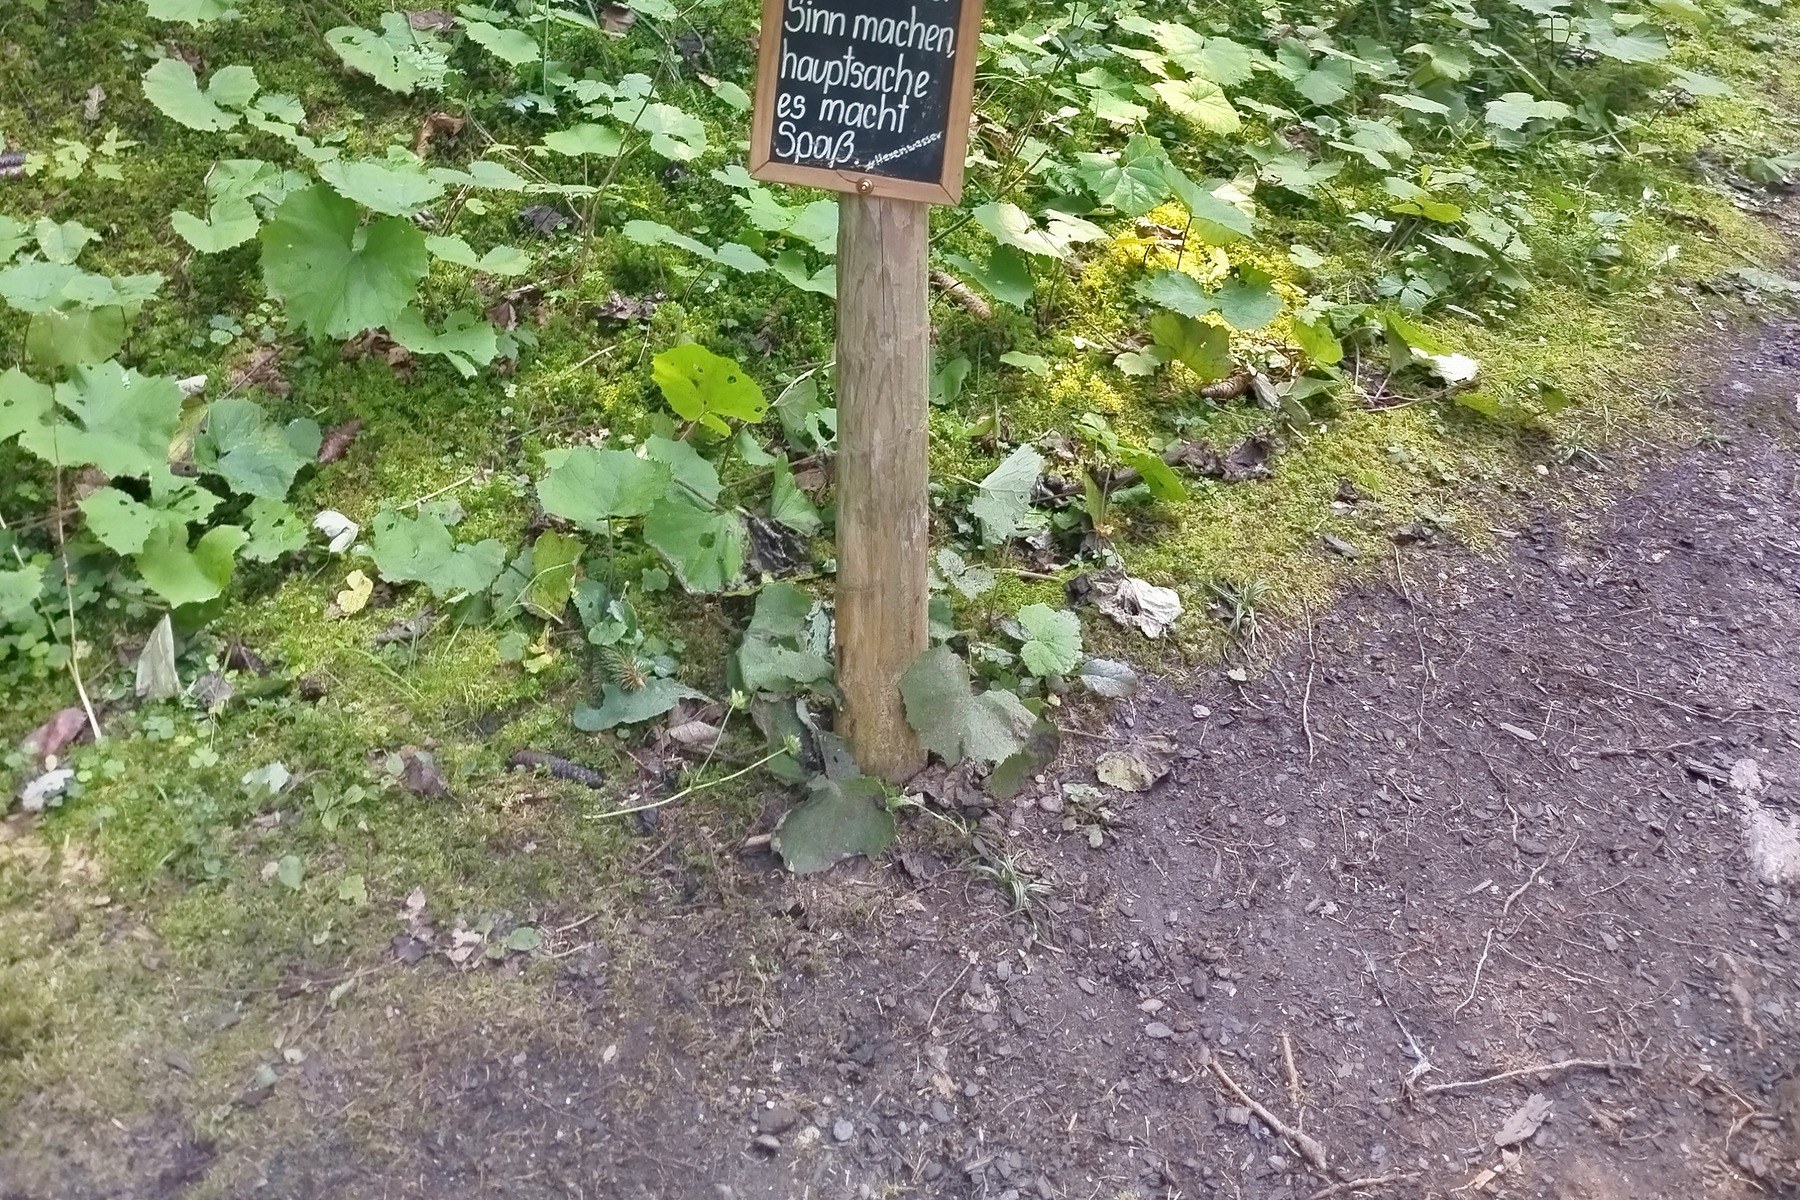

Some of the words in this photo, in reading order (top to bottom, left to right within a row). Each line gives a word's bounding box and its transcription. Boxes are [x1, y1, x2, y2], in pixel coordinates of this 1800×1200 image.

[852, 6, 955, 58] machen,
[780, 38, 930, 98] hauptsache
[777, 92, 805, 119] es
[819, 94, 909, 133] macht
[775, 121, 860, 169] Spaß.
